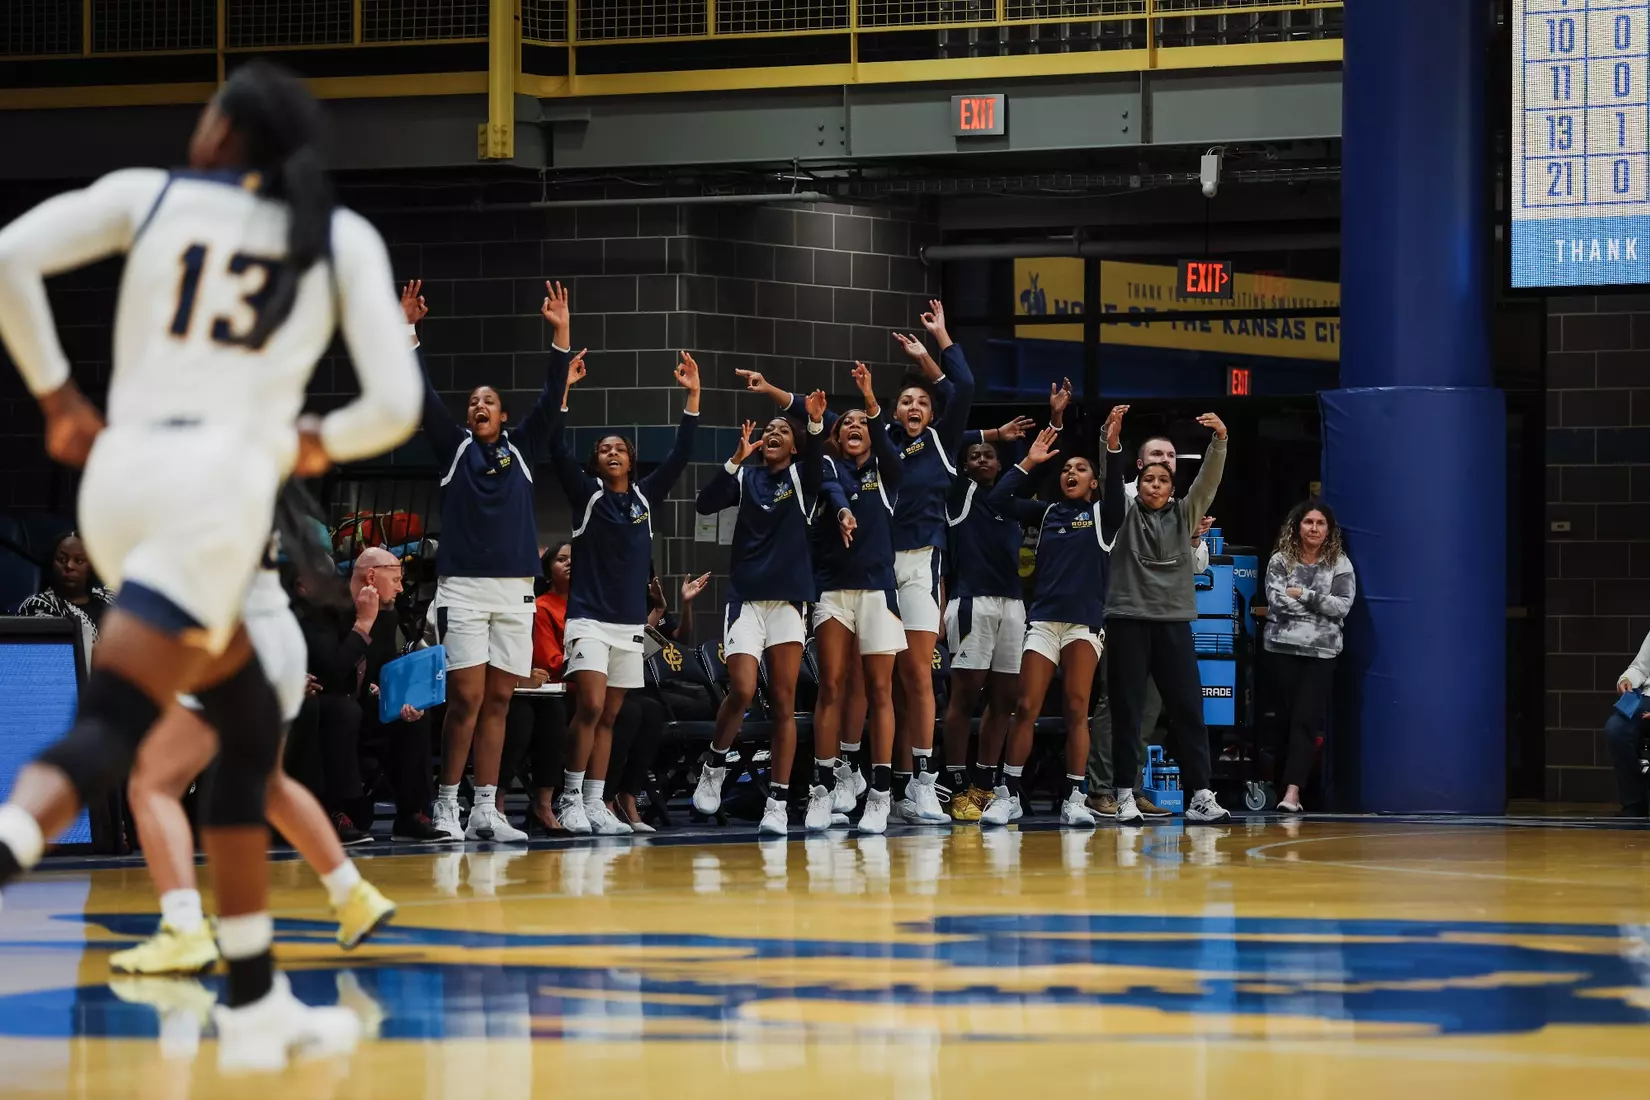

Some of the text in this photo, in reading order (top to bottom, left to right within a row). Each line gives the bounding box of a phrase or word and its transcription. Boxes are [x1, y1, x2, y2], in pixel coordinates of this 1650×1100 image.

[1546, 15, 1630, 53] 10 0
[1550, 62, 1630, 100] 11 0
[960, 98, 996, 129] EXIT
[1546, 112, 1625, 151] 13 1
[1547, 159, 1629, 197] 21 0
[1556, 238, 1638, 263] THANK
[1128, 282, 1162, 300] THANK
[1187, 262, 1223, 293] EXIT
[169, 243, 286, 353] 13
[1054, 298, 1118, 326] HOE
[1223, 318, 1306, 341] KANSAS
[1232, 369, 1248, 395] EXIT
